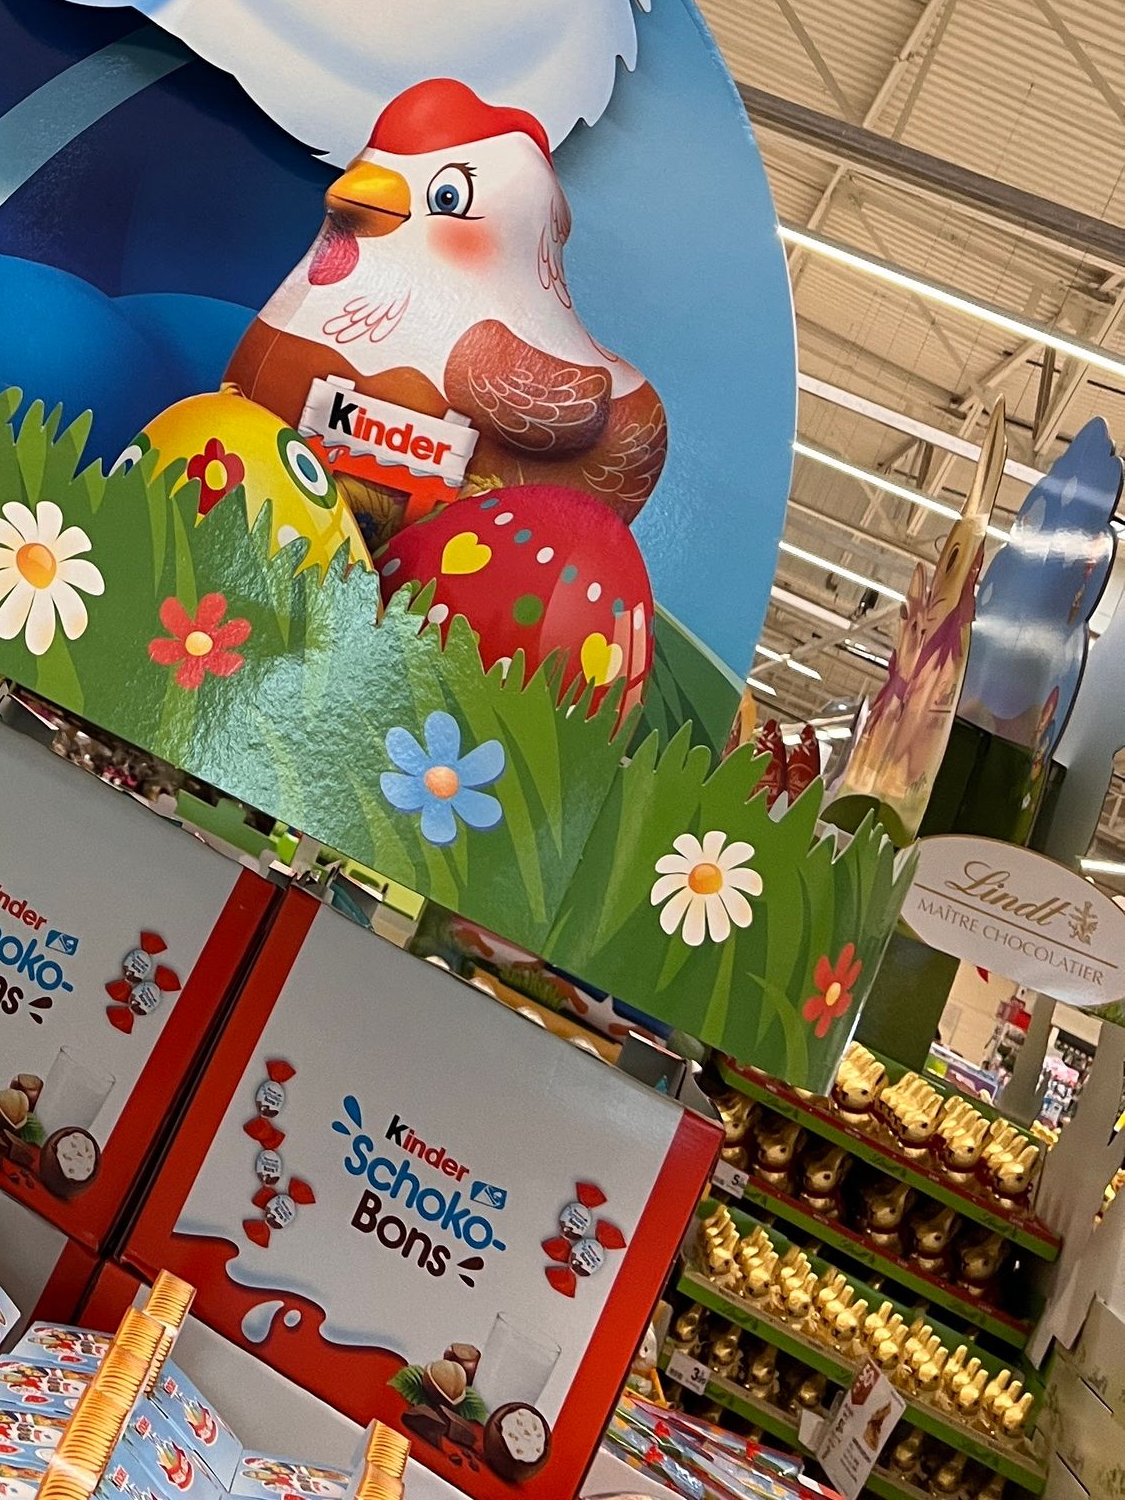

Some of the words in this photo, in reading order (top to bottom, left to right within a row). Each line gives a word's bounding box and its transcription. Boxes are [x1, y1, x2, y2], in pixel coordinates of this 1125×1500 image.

[327, 391, 452, 466] Kinder
[944, 861, 1072, 927] Lindt
[916, 897, 979, 934] MAÎTRE
[982, 924, 1105, 987] CHOCOLATIER
[384, 1114, 470, 1182] Kinder
[343, 1133, 507, 1252] Schoko-
[350, 1188, 452, 1277] Bons
